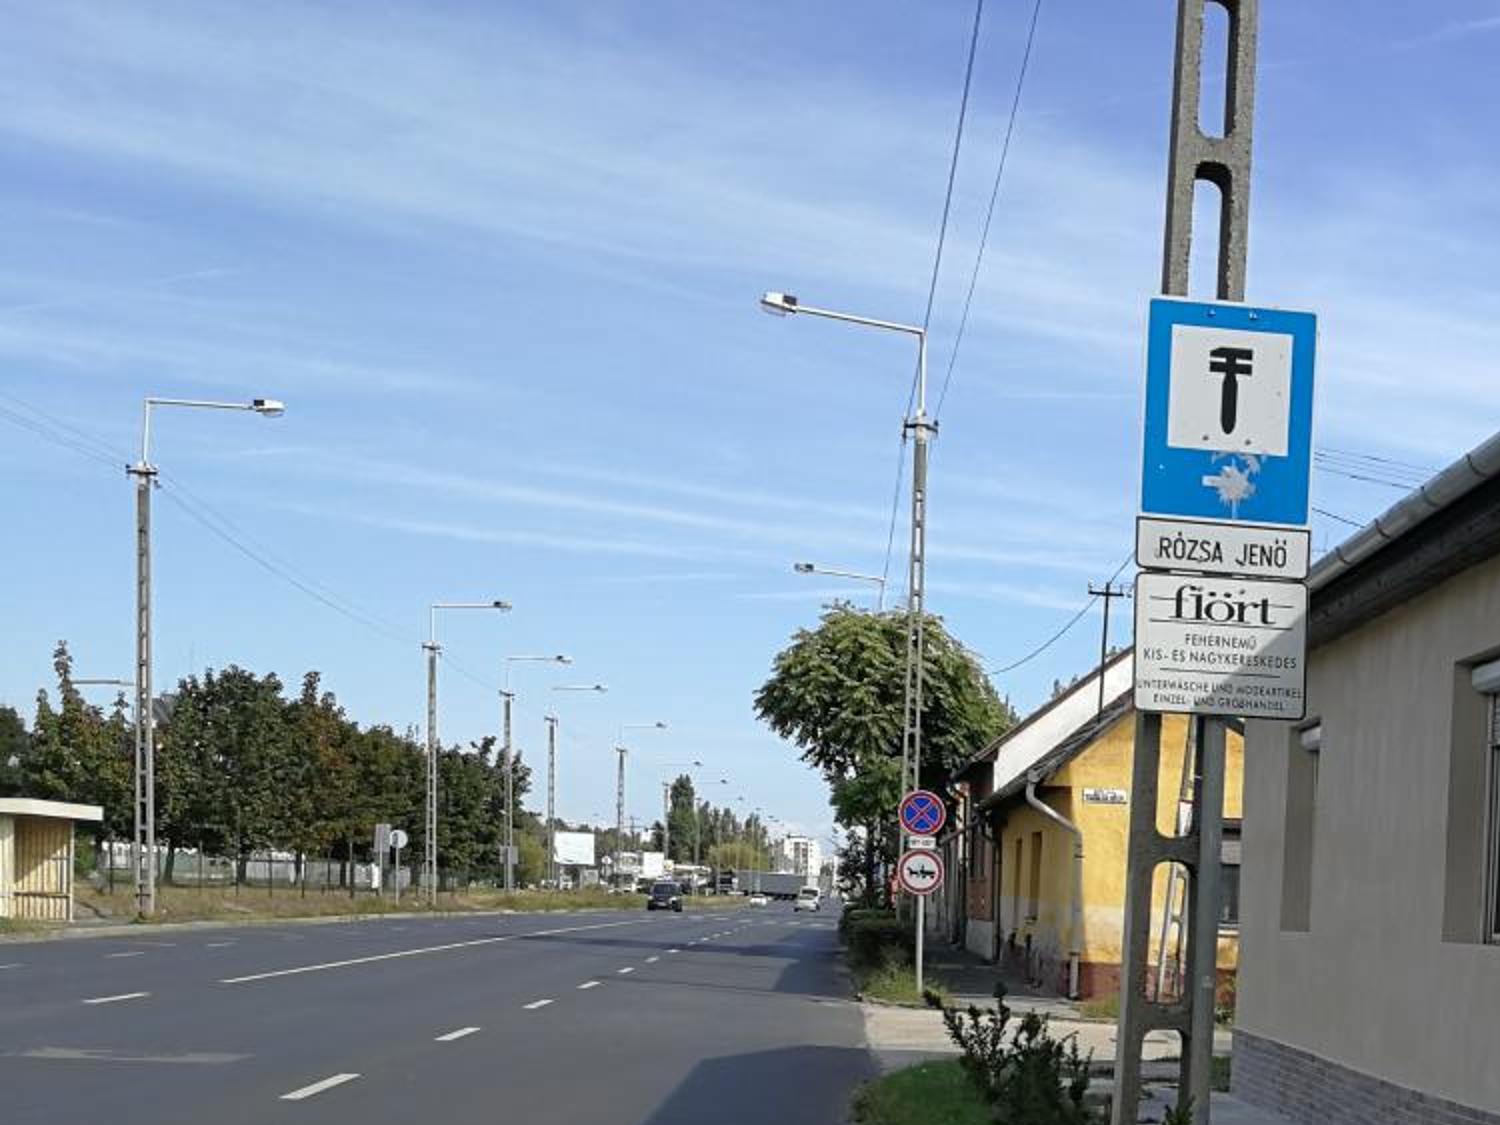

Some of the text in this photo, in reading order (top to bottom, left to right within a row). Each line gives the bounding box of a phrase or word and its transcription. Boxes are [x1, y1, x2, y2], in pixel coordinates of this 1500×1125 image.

[1158, 531, 1223, 563] RÓZSA
[1168, 584, 1276, 625] fiört
[1143, 647, 1169, 661] KIS-
